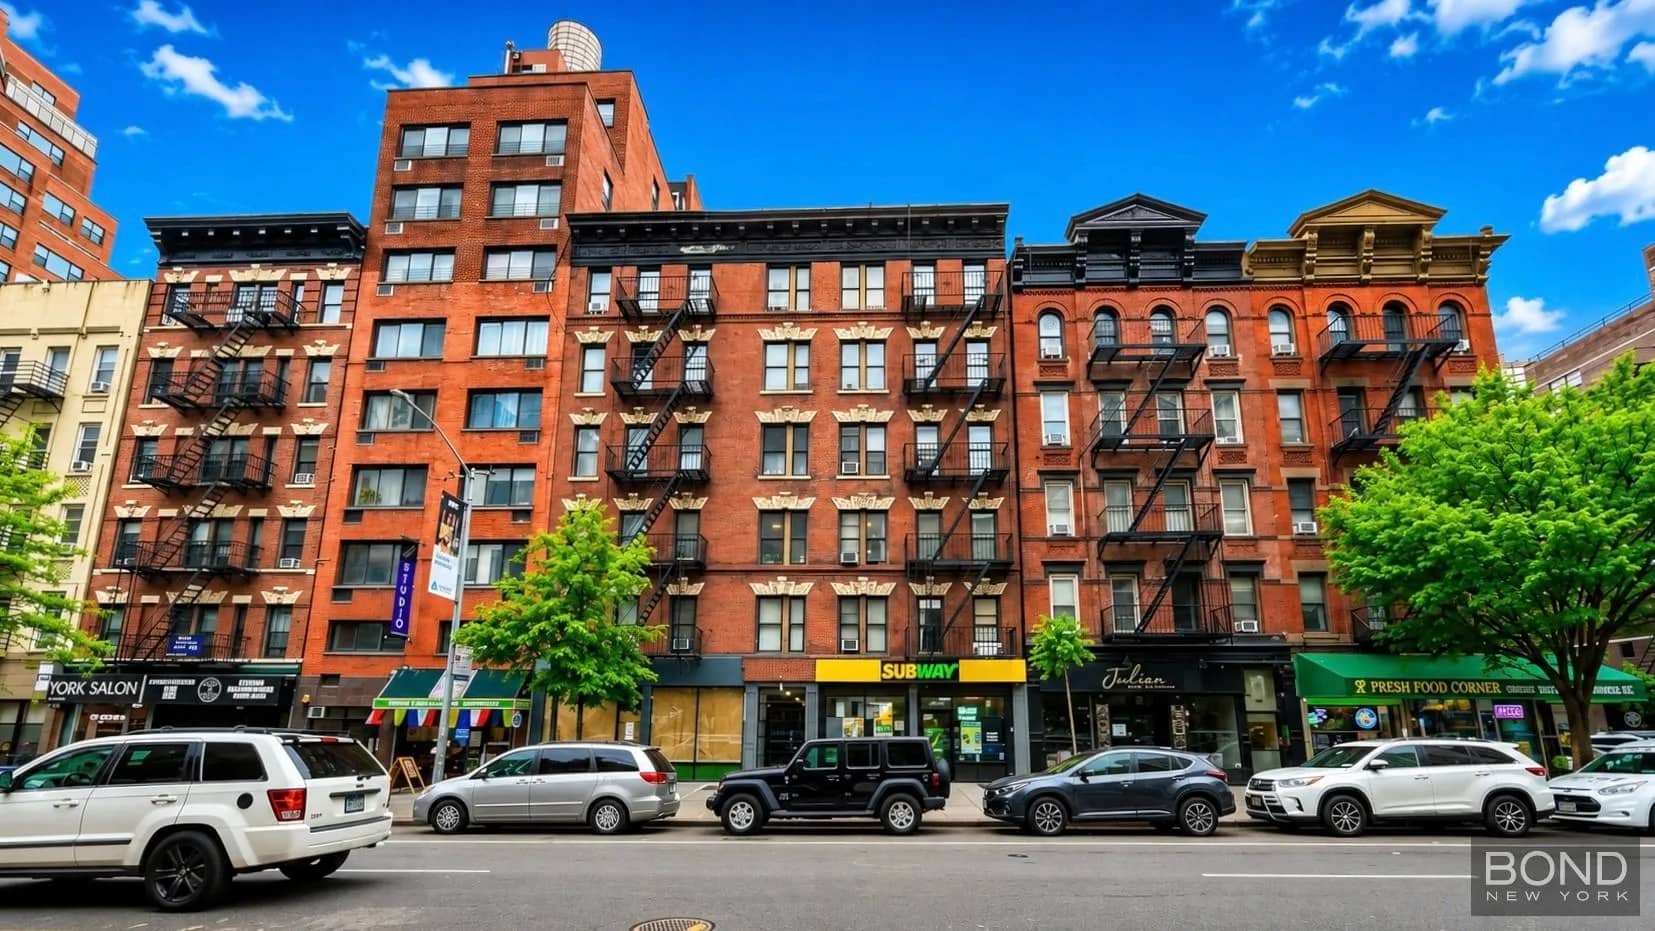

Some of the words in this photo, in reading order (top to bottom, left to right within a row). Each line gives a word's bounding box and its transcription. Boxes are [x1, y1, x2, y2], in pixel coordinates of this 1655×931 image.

[395, 562, 410, 629] STUDIO
[882, 663, 957, 679] SUBWAY
[1102, 663, 1166, 689] Julian
[49, 681, 87, 695] YORK
[89, 681, 138, 695] SALON
[1414, 681, 1448, 694] FOOD
[1450, 681, 1502, 694] CORNER
